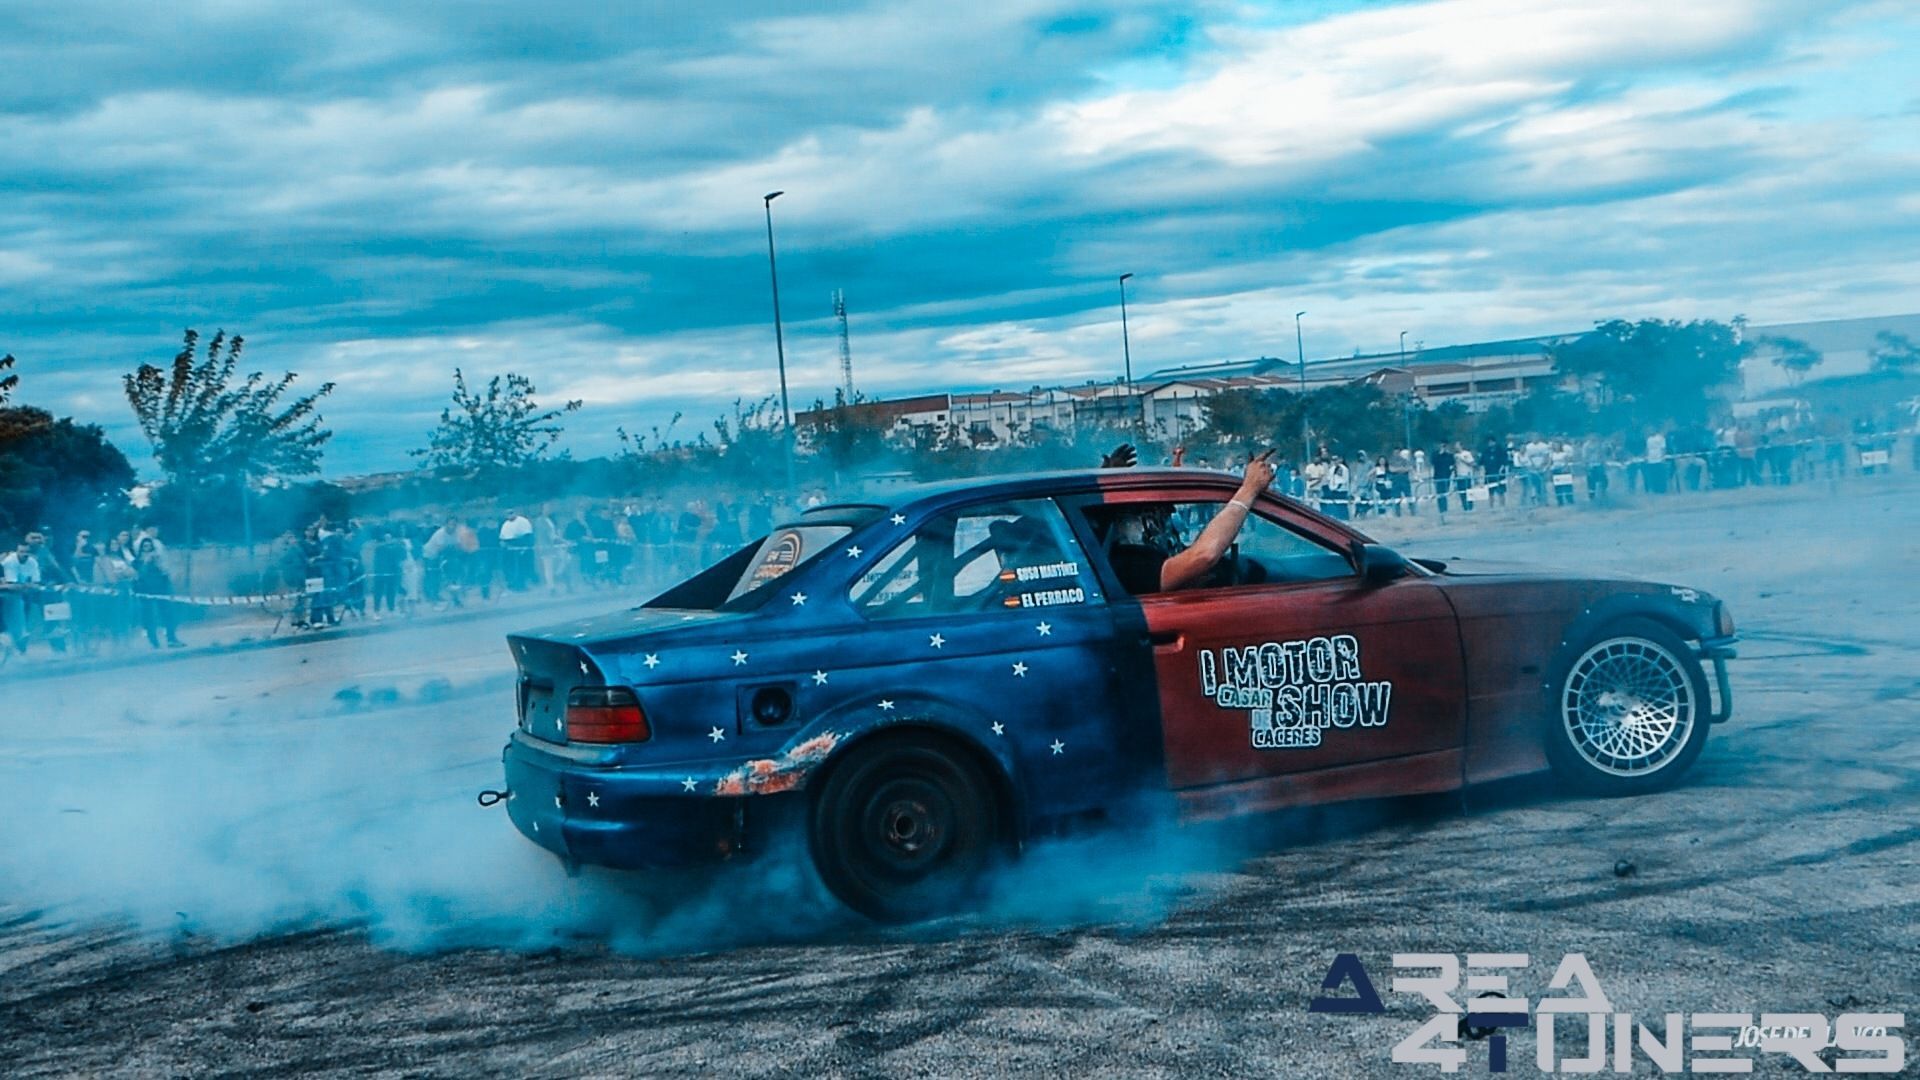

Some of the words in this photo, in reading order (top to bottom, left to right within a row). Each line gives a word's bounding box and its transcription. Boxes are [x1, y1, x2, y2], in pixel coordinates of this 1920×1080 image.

[1016, 566, 1039, 581] SUSO
[1021, 593, 1035, 608] EL
[1034, 588, 1084, 606] PERRACO
[1224, 635, 1361, 690] MOTOR
[1277, 681, 1391, 728] SHOW
